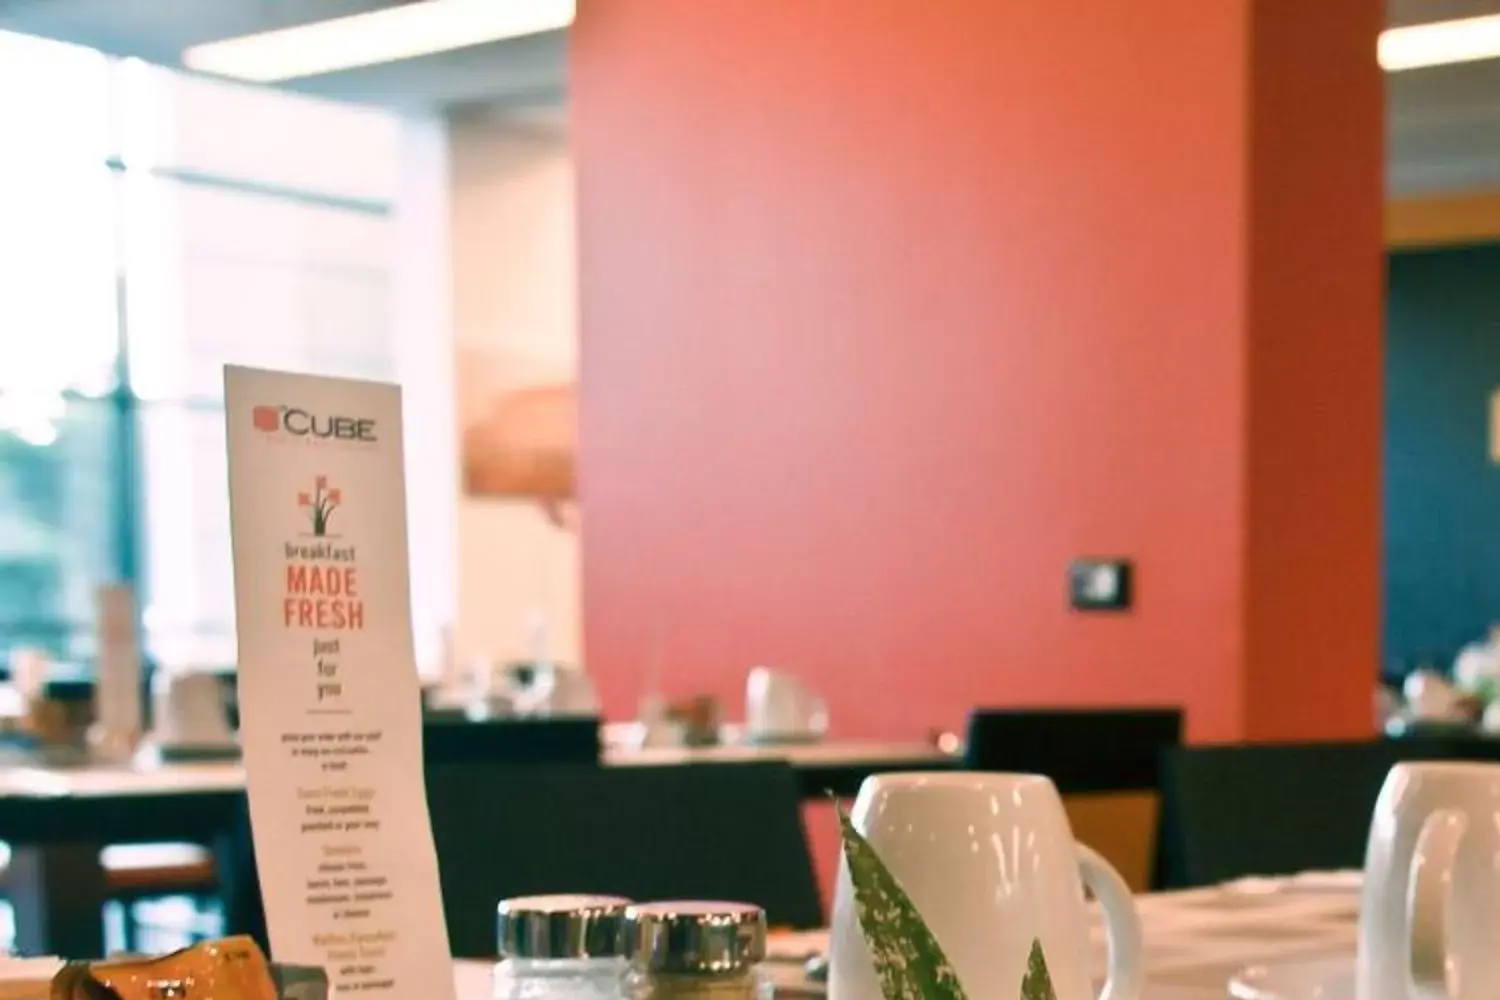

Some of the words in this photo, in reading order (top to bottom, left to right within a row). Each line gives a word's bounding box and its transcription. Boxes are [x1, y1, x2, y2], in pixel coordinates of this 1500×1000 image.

[283, 408, 378, 442] CUBE
[284, 542, 356, 562] breakfast
[286, 565, 358, 597] MADE
[283, 598, 364, 630] FRESH
[313, 638, 340, 659] just
[317, 658, 337, 677] for
[317, 683, 342, 702] you
